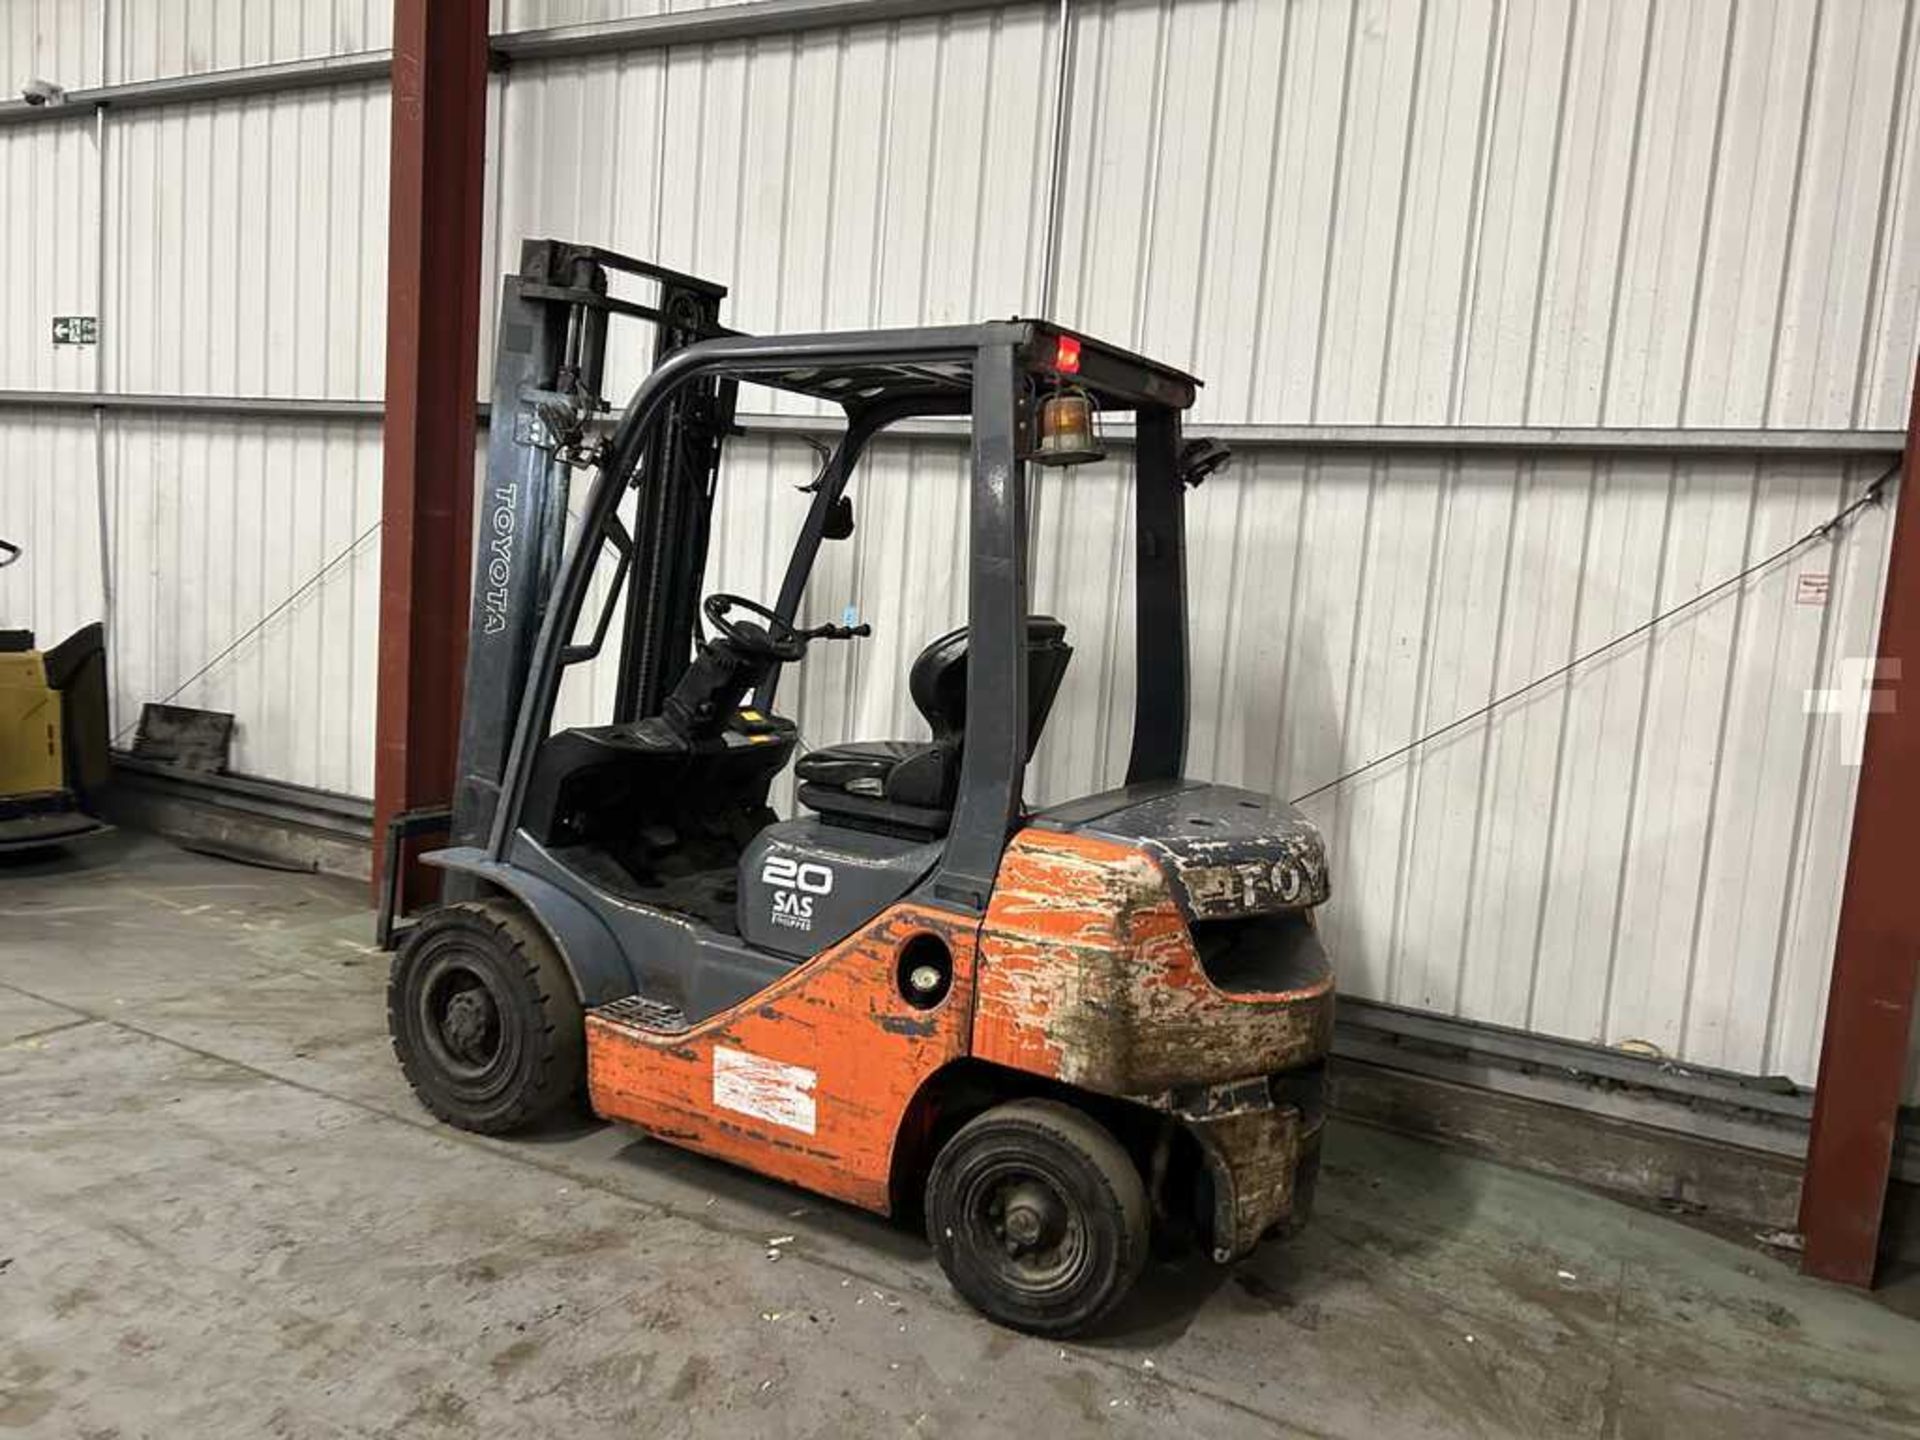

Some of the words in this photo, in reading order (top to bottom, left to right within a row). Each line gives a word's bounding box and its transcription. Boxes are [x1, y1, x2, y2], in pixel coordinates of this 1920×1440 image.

[483, 483, 517, 634] TOYOTA
[762, 856, 833, 895] 20
[773, 890, 813, 917] SAS
